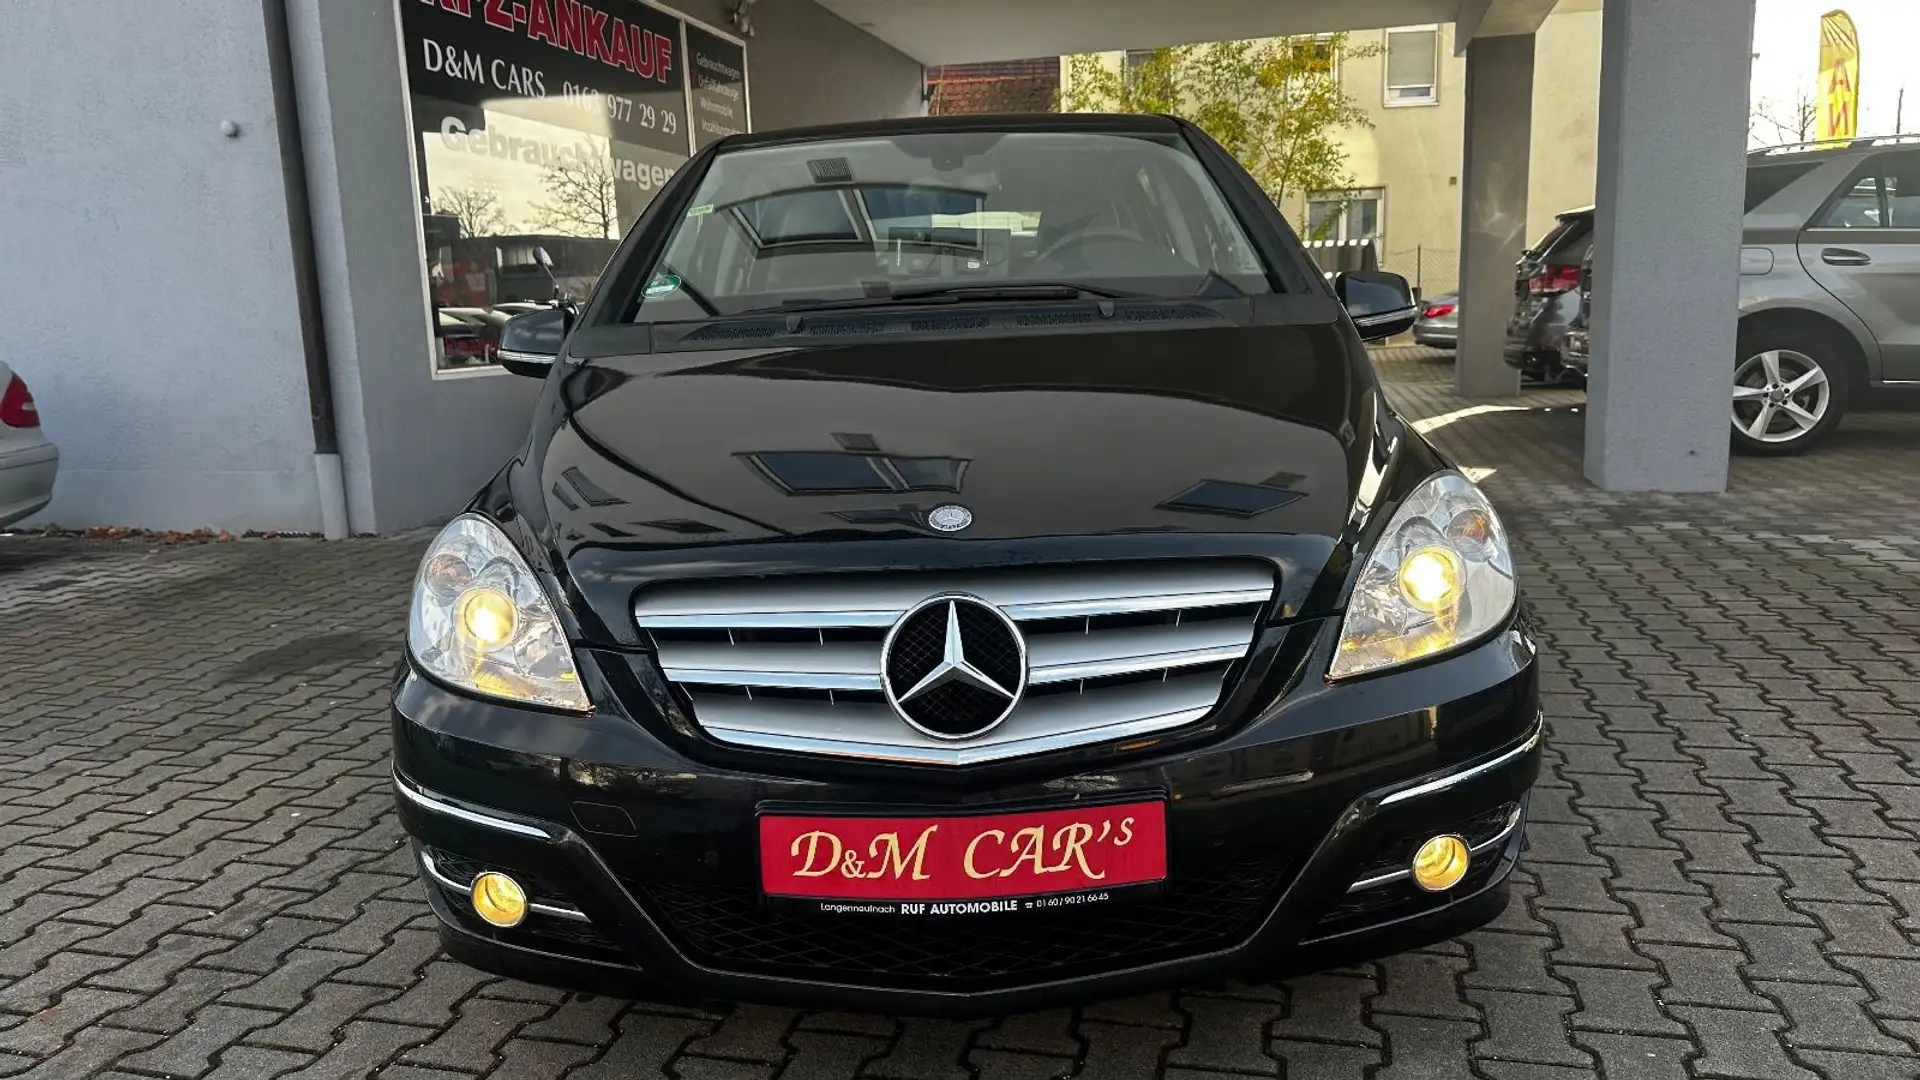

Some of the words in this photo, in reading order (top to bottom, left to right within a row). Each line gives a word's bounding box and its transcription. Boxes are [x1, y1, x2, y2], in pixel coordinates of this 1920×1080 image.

[417, 0, 672, 83] Z-ANKAUF
[422, 37, 485, 85] D&M
[490, 58, 547, 98] CARS
[606, 93, 633, 123] 977
[639, 103, 656, 129] 29
[660, 109, 677, 135] 29
[790, 824, 939, 881] D&M
[963, 816, 1135, 881] CAR's
[901, 903, 926, 915] RUF
[929, 899, 1018, 915] AUTOMOBILE
